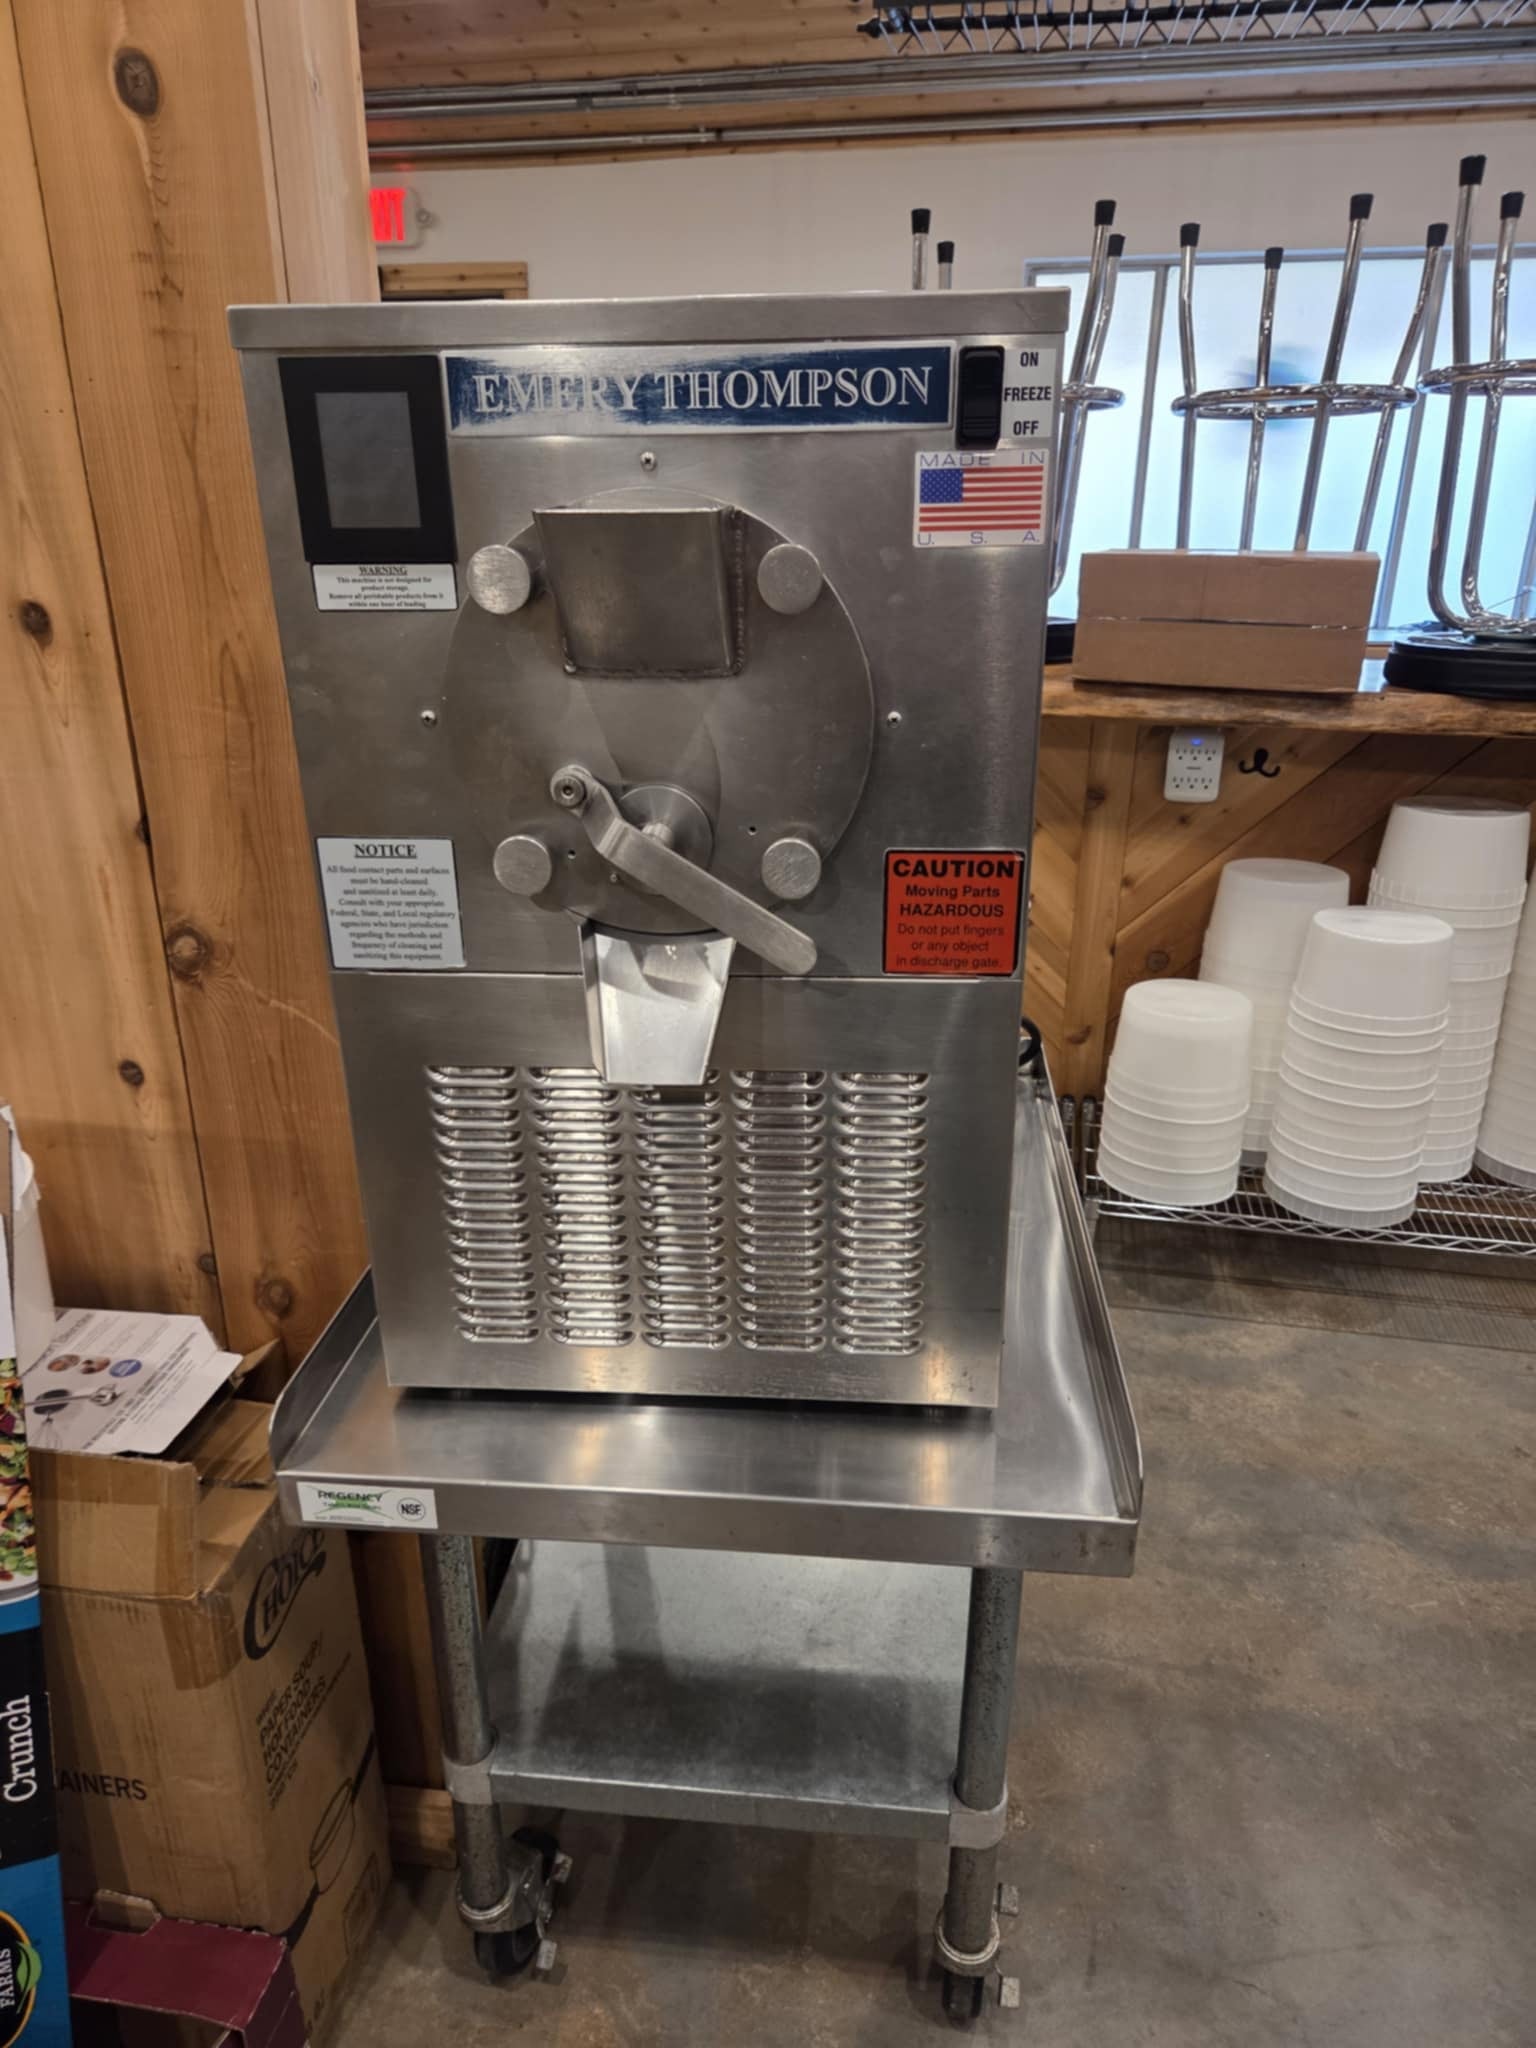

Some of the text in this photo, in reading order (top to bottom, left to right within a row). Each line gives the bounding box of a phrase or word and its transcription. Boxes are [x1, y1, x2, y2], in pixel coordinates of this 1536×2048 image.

[1020, 352, 1039, 367] ON
[472, 366, 932, 413] EMERY THOMPSON
[1004, 386, 1052, 401] FREEZE
[1013, 421, 1039, 435] OFF
[920, 451, 1045, 467] MADE IN
[358, 566, 408, 576] WARNING
[354, 844, 417, 859] NOTICE
[893, 859, 1015, 878] CAUTION
[905, 884, 1000, 899] Moving Parts
[900, 903, 1004, 918] HAZARDOUS
[897, 923, 1005, 938] Do not put fingers
[911, 940, 990, 955] or any object
[909, 956, 969, 970] discharge
[400, 1503, 422, 1516] NSF
[0, 1694, 38, 1802] Crunch
[58, 1769, 148, 1801] AINERS
